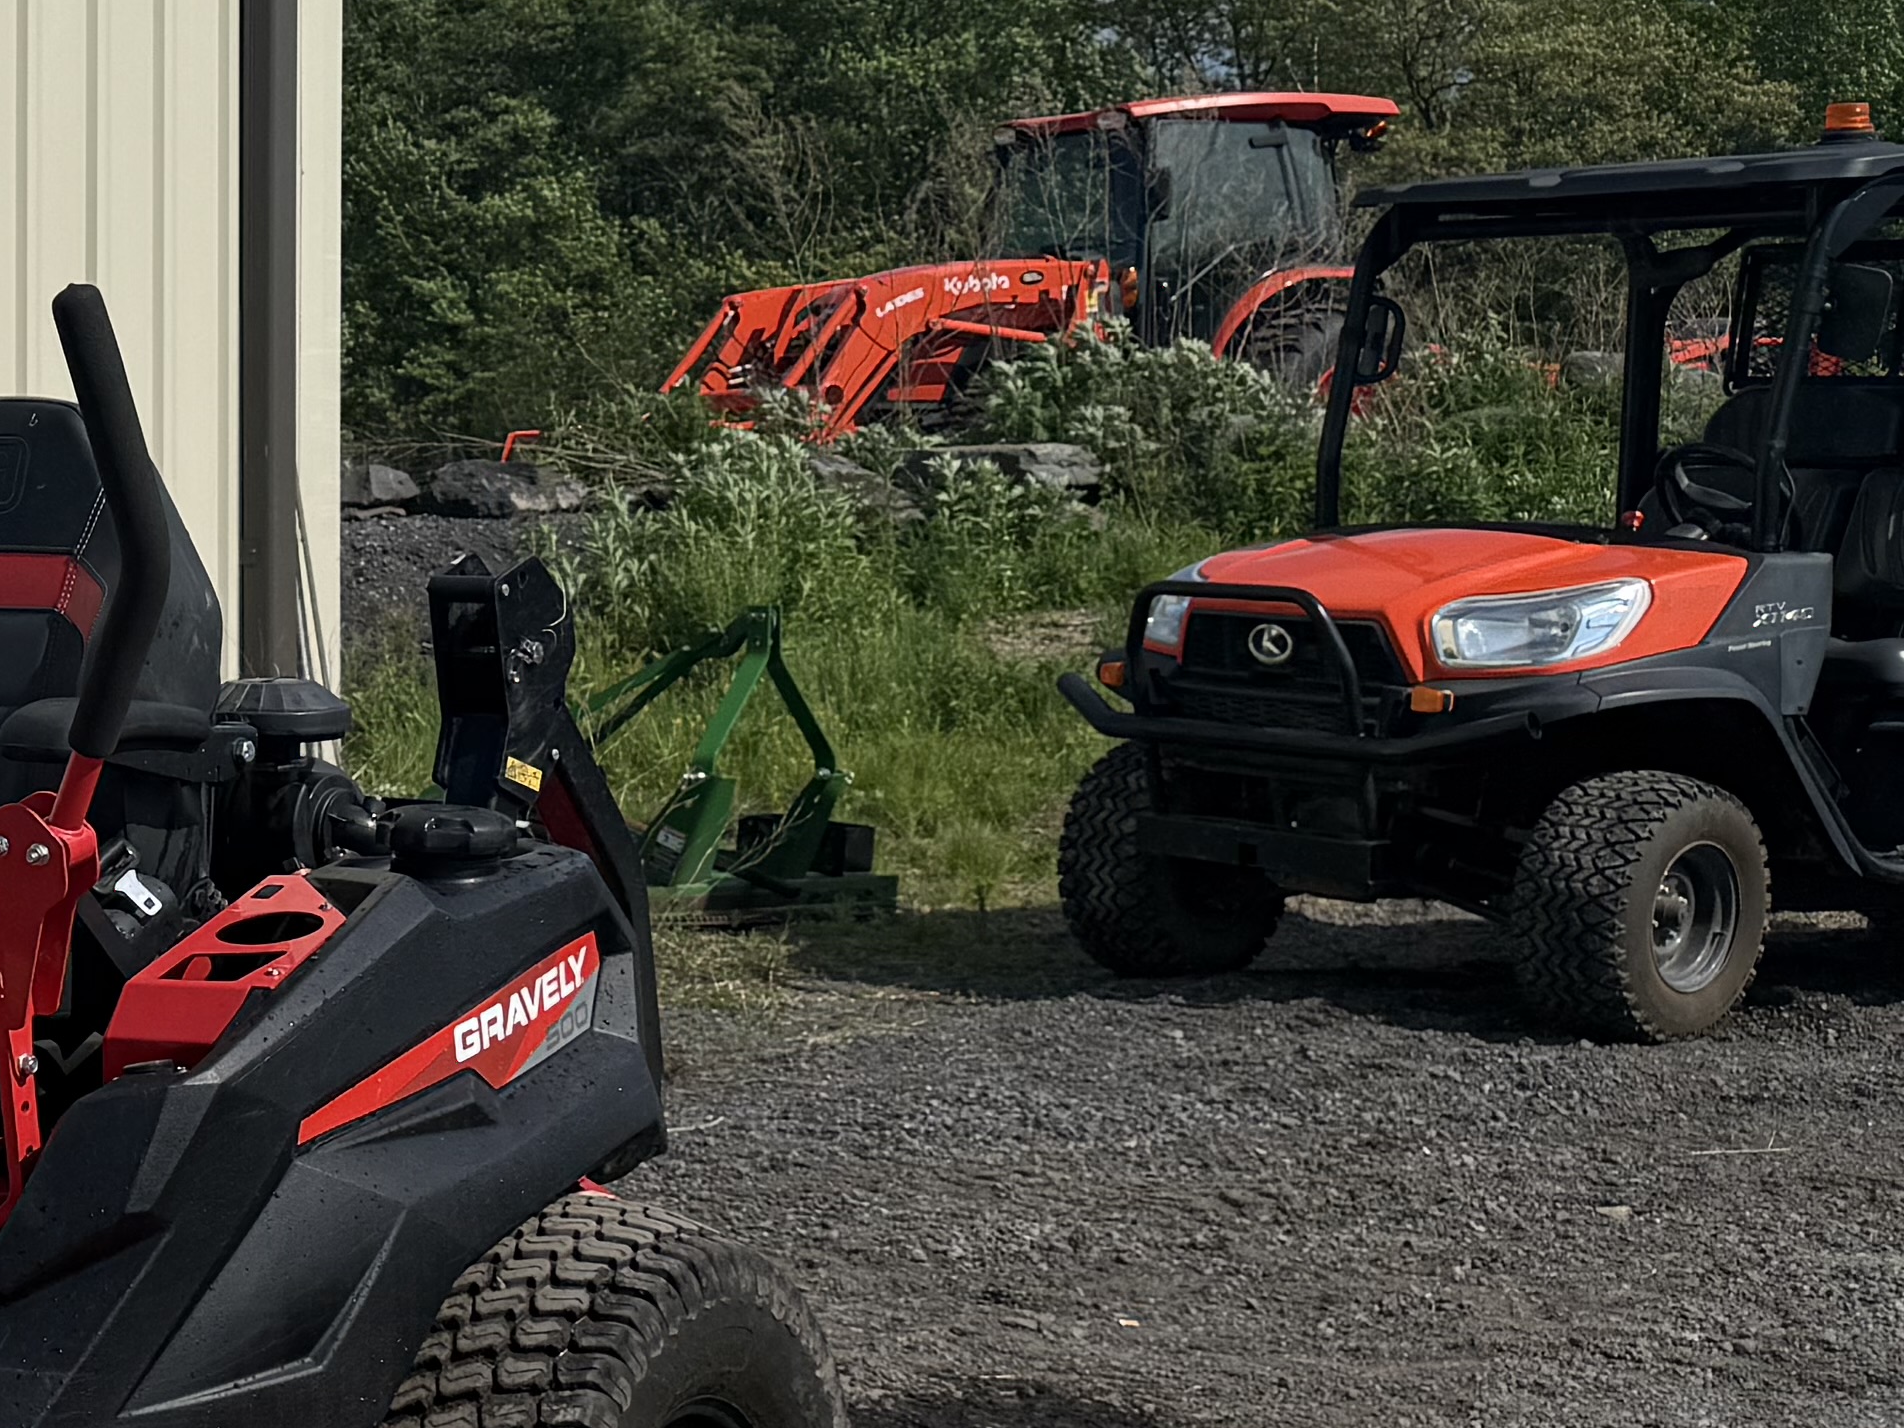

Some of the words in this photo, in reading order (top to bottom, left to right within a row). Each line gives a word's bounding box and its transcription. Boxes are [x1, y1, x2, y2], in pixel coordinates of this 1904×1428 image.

[944, 272, 1011, 296] Kubota
[1755, 601, 1787, 618] RTV
[453, 945, 587, 1063] GRAVELY
